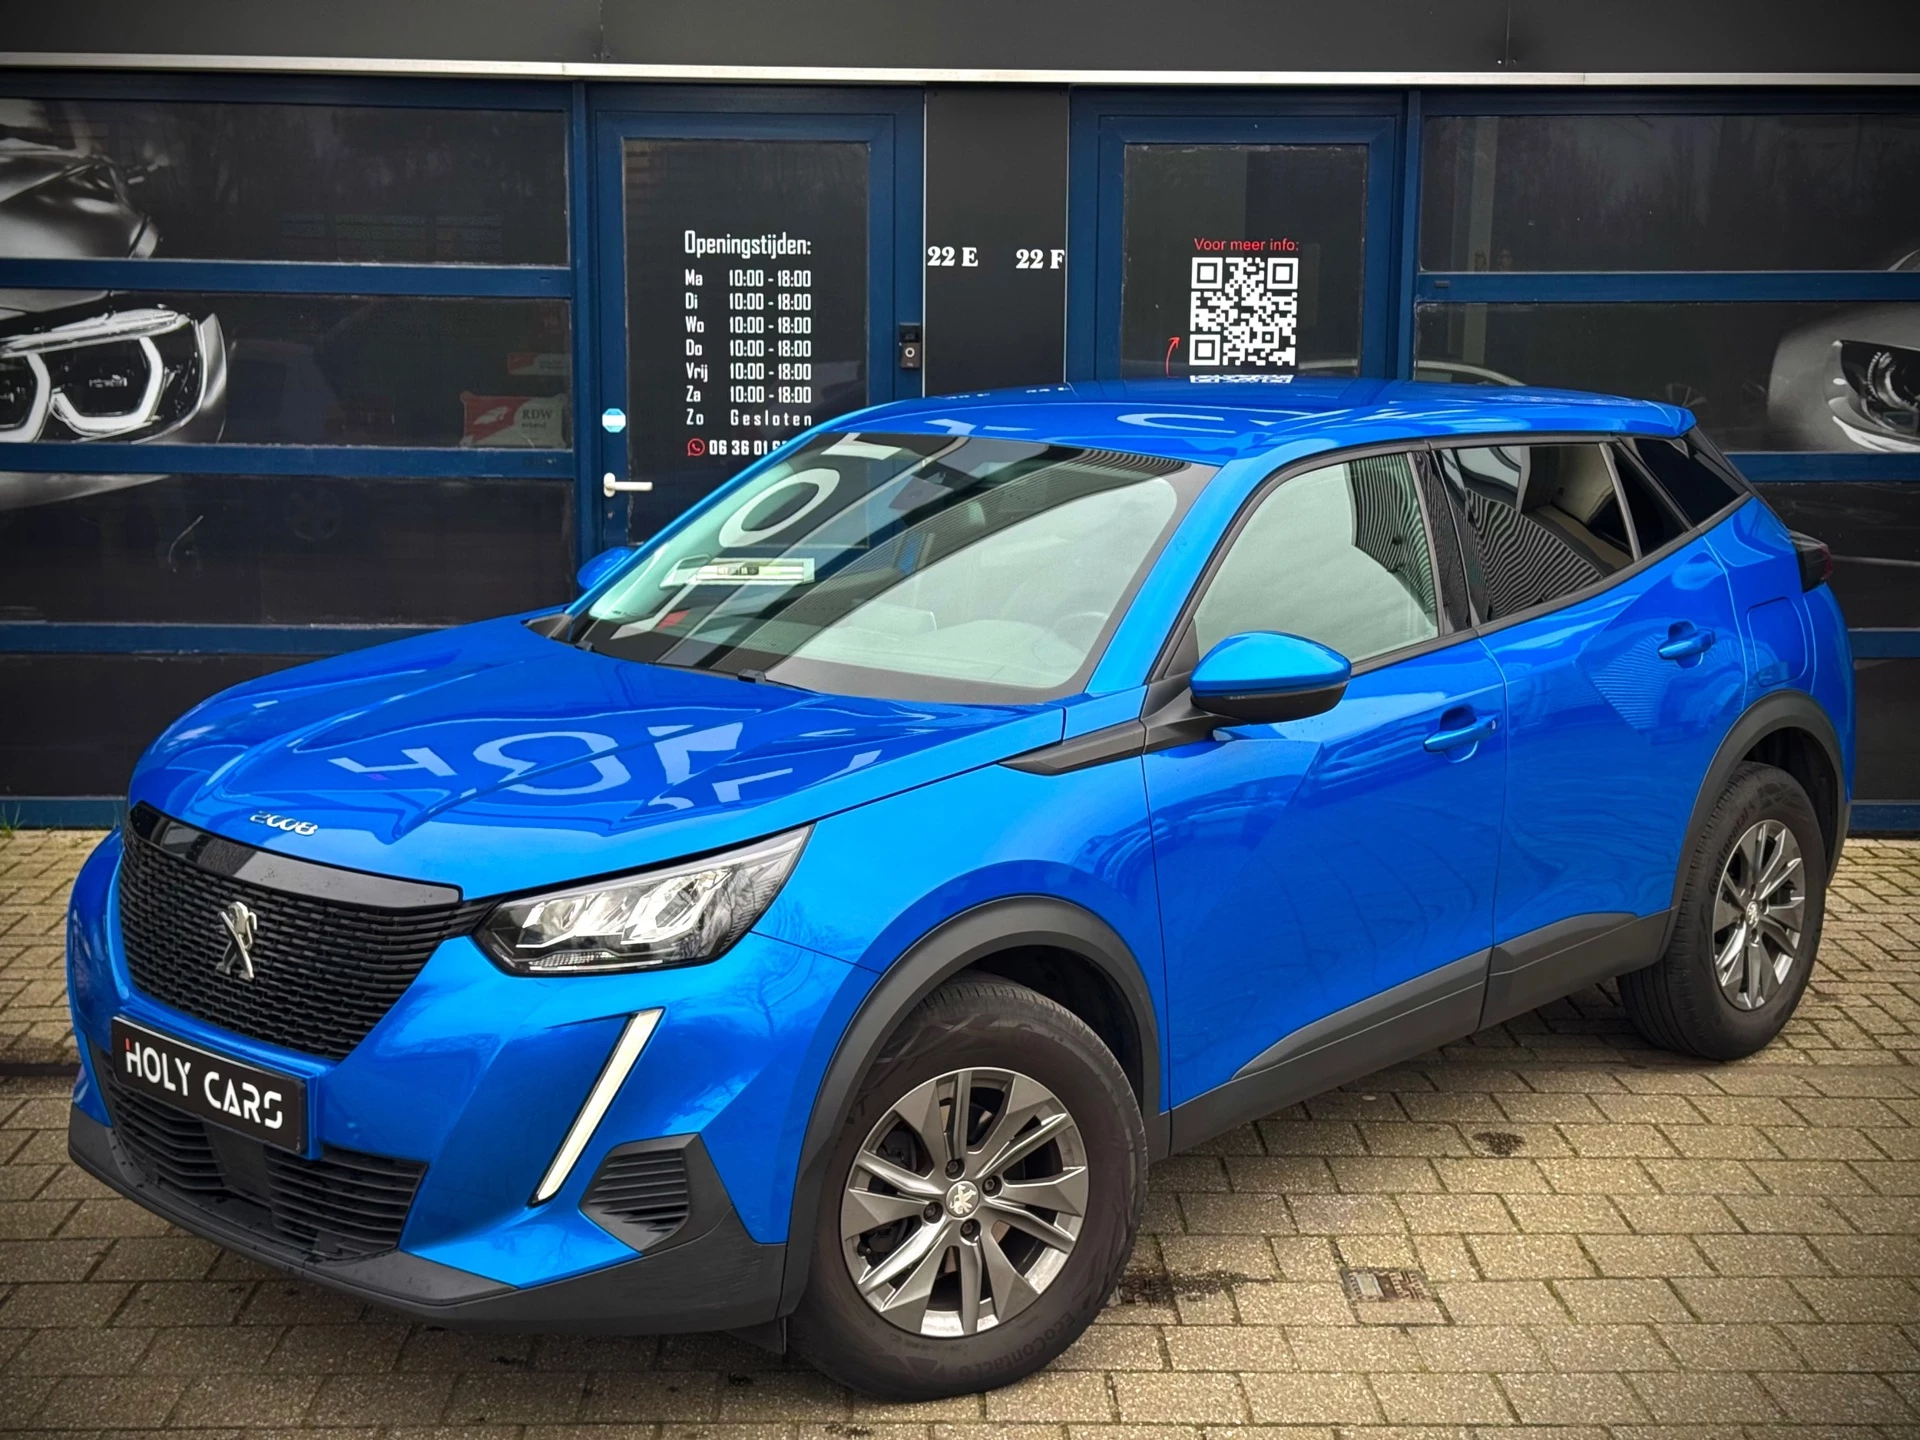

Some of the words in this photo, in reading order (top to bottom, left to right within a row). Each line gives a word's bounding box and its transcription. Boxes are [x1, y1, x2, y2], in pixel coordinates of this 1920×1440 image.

[684, 229, 812, 259] Openingstijden:
[1194, 238, 1226, 252] Voor
[1231, 241, 1264, 252] meer
[1269, 238, 1299, 252] info:
[926, 245, 955, 267] 22
[961, 246, 979, 268] E
[1015, 248, 1044, 270] 22
[1049, 249, 1065, 270] F
[684, 269, 703, 287] Ma
[729, 269, 764, 287] 10:00
[777, 269, 812, 287] 18:00
[685, 292, 698, 310] Di
[729, 292, 764, 311] 10:00
[777, 292, 812, 311] 18:00
[685, 316, 705, 334] Wo
[729, 316, 764, 334] 10:00
[777, 316, 812, 334] 18:00
[685, 339, 703, 357] Do
[729, 339, 764, 358] 10:00
[777, 339, 812, 358] 18:00
[686, 362, 709, 383] Vrij
[729, 362, 764, 381] 10:00
[777, 362, 812, 381] 18:00
[686, 385, 702, 403] Za
[729, 385, 764, 404] 10:00
[777, 385, 812, 404] 18:00
[522, 408, 553, 420] RDW
[686, 408, 705, 426] Zo
[730, 408, 812, 427] Gesloten
[708, 440, 727, 456] 06
[731, 440, 750, 456] 36
[753, 440, 768, 456] 01
[250, 811, 318, 836] 2008
[125, 1038, 192, 1097] HOLY
[203, 1072, 284, 1130] CARS
